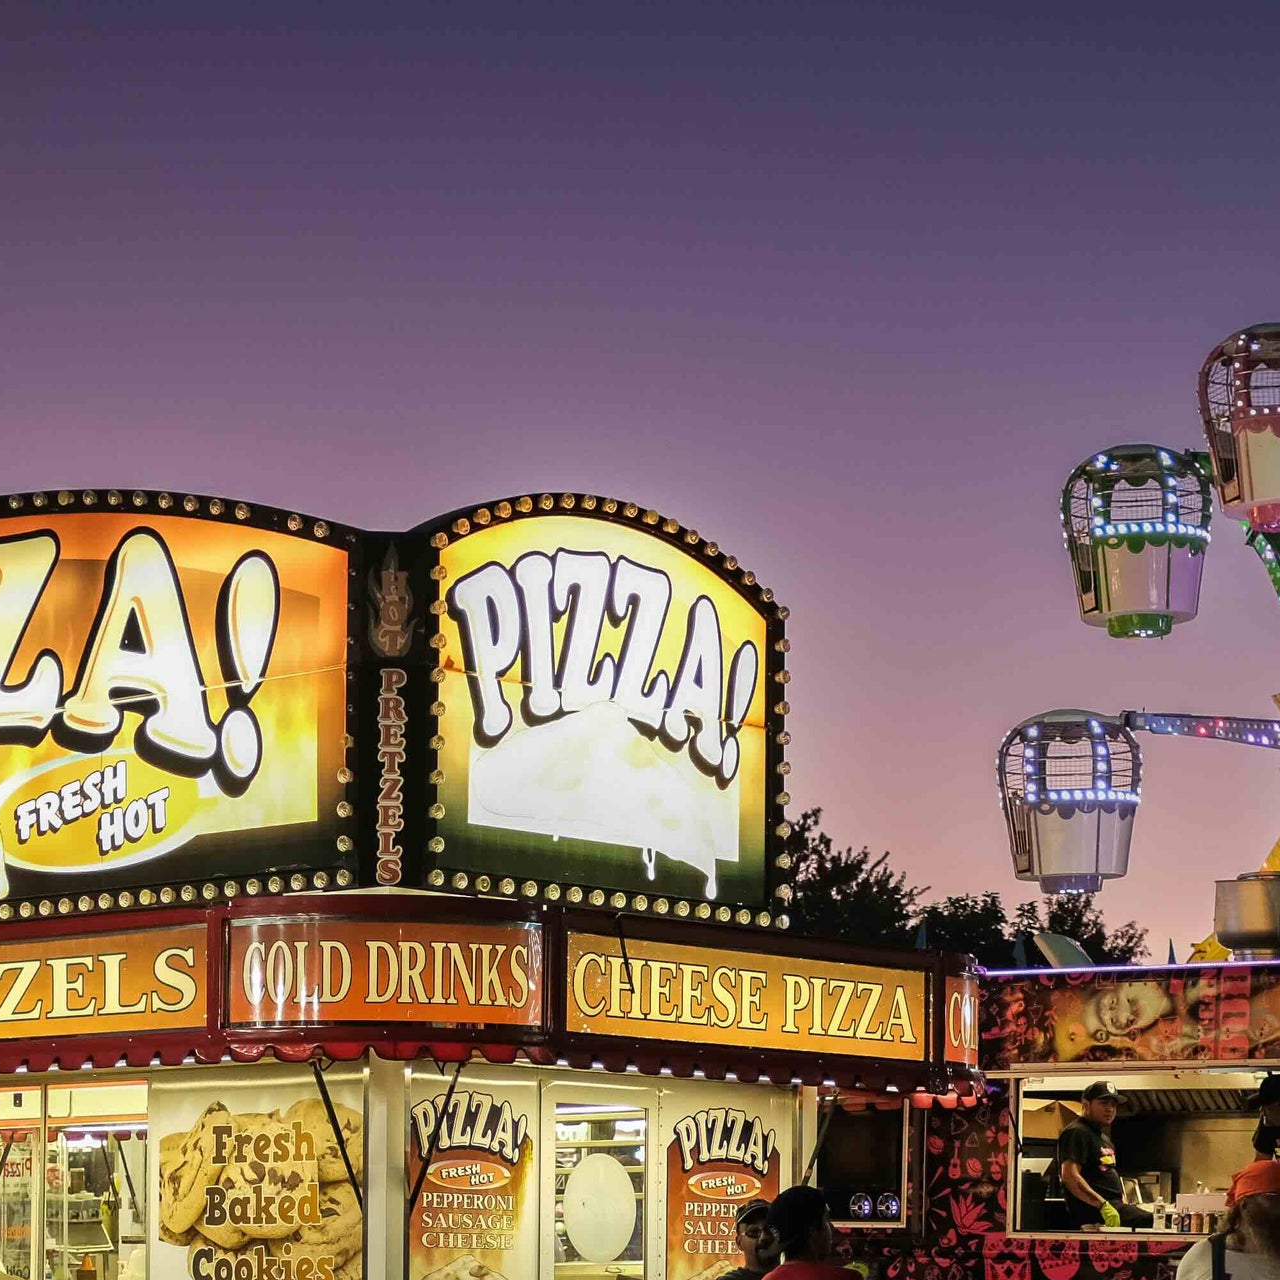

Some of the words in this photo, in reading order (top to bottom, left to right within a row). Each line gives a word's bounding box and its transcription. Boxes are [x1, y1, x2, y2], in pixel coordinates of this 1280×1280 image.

[449, 547, 758, 790] PIZZA!
[376, 667, 408, 886] PRETZELS
[15, 760, 127, 844] FRESH
[97, 787, 170, 857] HOT
[242, 940, 352, 1007] COLD
[365, 940, 530, 1009] DRINKS
[572, 952, 768, 1031] CHEESE
[781, 974, 917, 1043] PIZZA
[212, 1120, 316, 1165] Fresh
[411, 1091, 527, 1166] PIZZA!
[674, 1108, 775, 1176] PIZZA!
[440, 1163, 481, 1179] FRESH
[470, 1172, 495, 1185] HOT
[701, 1175, 736, 1190] FRESH
[422, 1192, 514, 1211] PEPPERONI
[726, 1183, 748, 1196] HOT
[205, 1184, 321, 1226] Baked
[684, 1202, 738, 1217] PEPPER
[421, 1212, 514, 1230] SAUSAGE
[684, 1220, 737, 1236] SAUSA
[421, 1233, 514, 1250] CHEESE
[684, 1239, 742, 1254] CHEE
